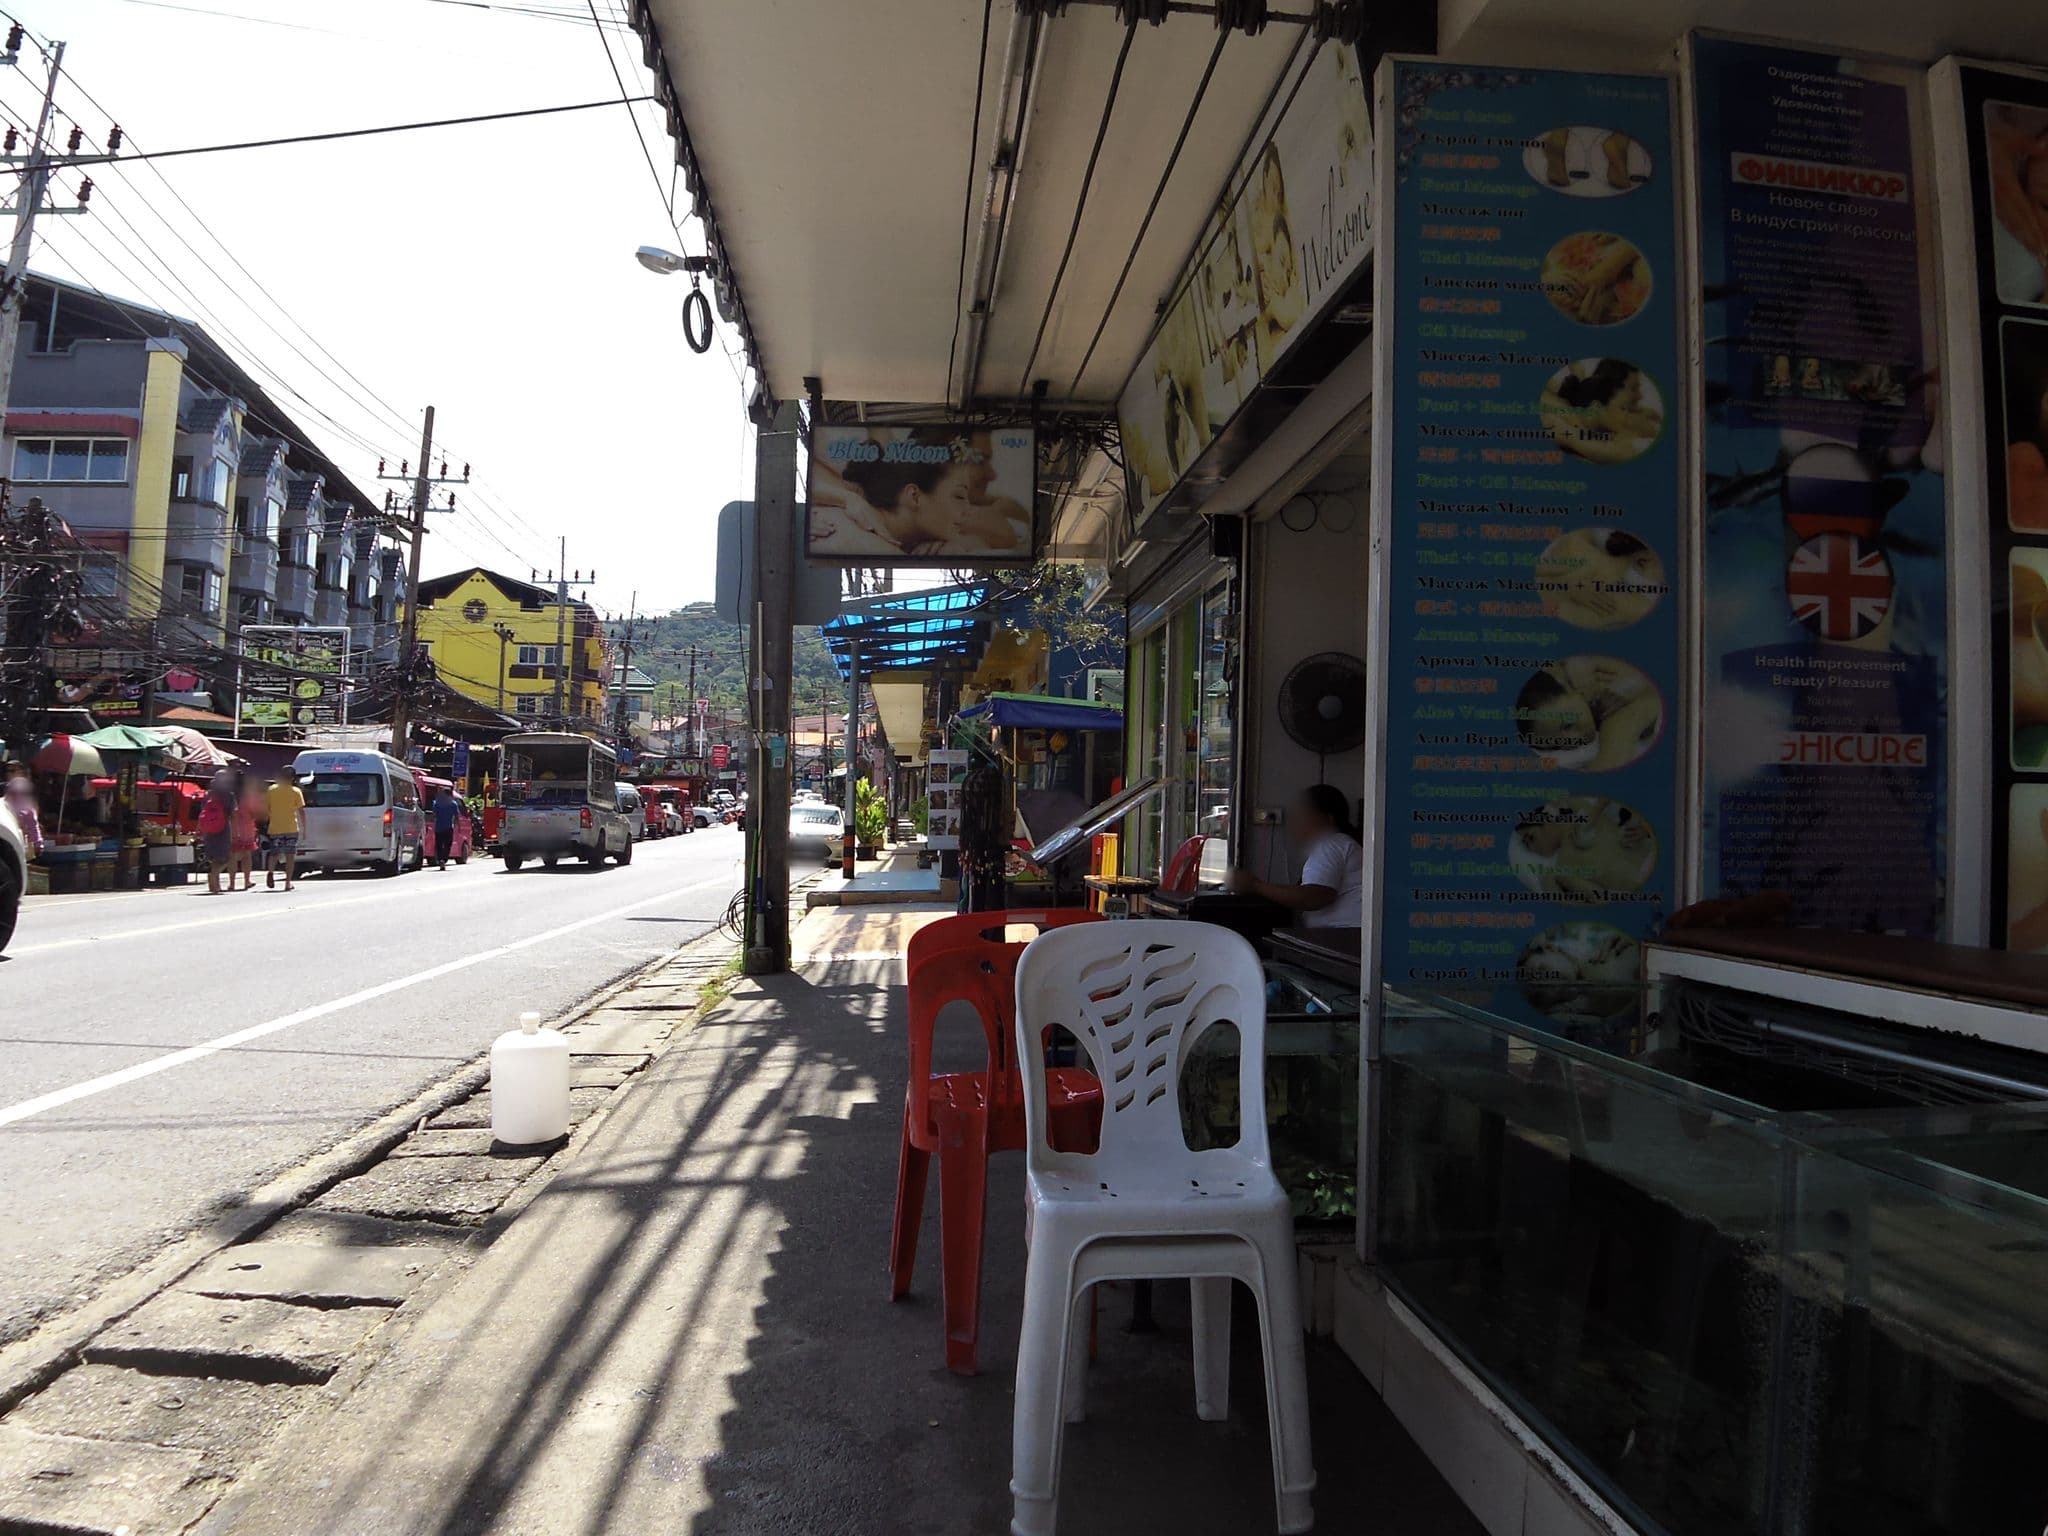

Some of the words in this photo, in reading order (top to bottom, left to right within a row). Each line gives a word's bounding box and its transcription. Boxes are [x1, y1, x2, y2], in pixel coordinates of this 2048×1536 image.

[1791, 84, 1843, 100] Красота
[1740, 158, 1905, 198] ФИШИКЮР
[1768, 191, 1825, 211] Новое
[1828, 201, 1880, 218] слово
[1731, 207, 1742, 223] В
[1745, 211, 1839, 234] индустрии
[1302, 164, 1375, 306] Welcome
[828, 439, 882, 463] Blue
[882, 440, 952, 464] Moon
[1417, 500, 1490, 513] Массаж
[1416, 577, 1490, 590] Массаж
[1754, 655, 1805, 669] Health
[1771, 675, 1824, 690] Beauty
[1828, 676, 1892, 690] Pleasure
